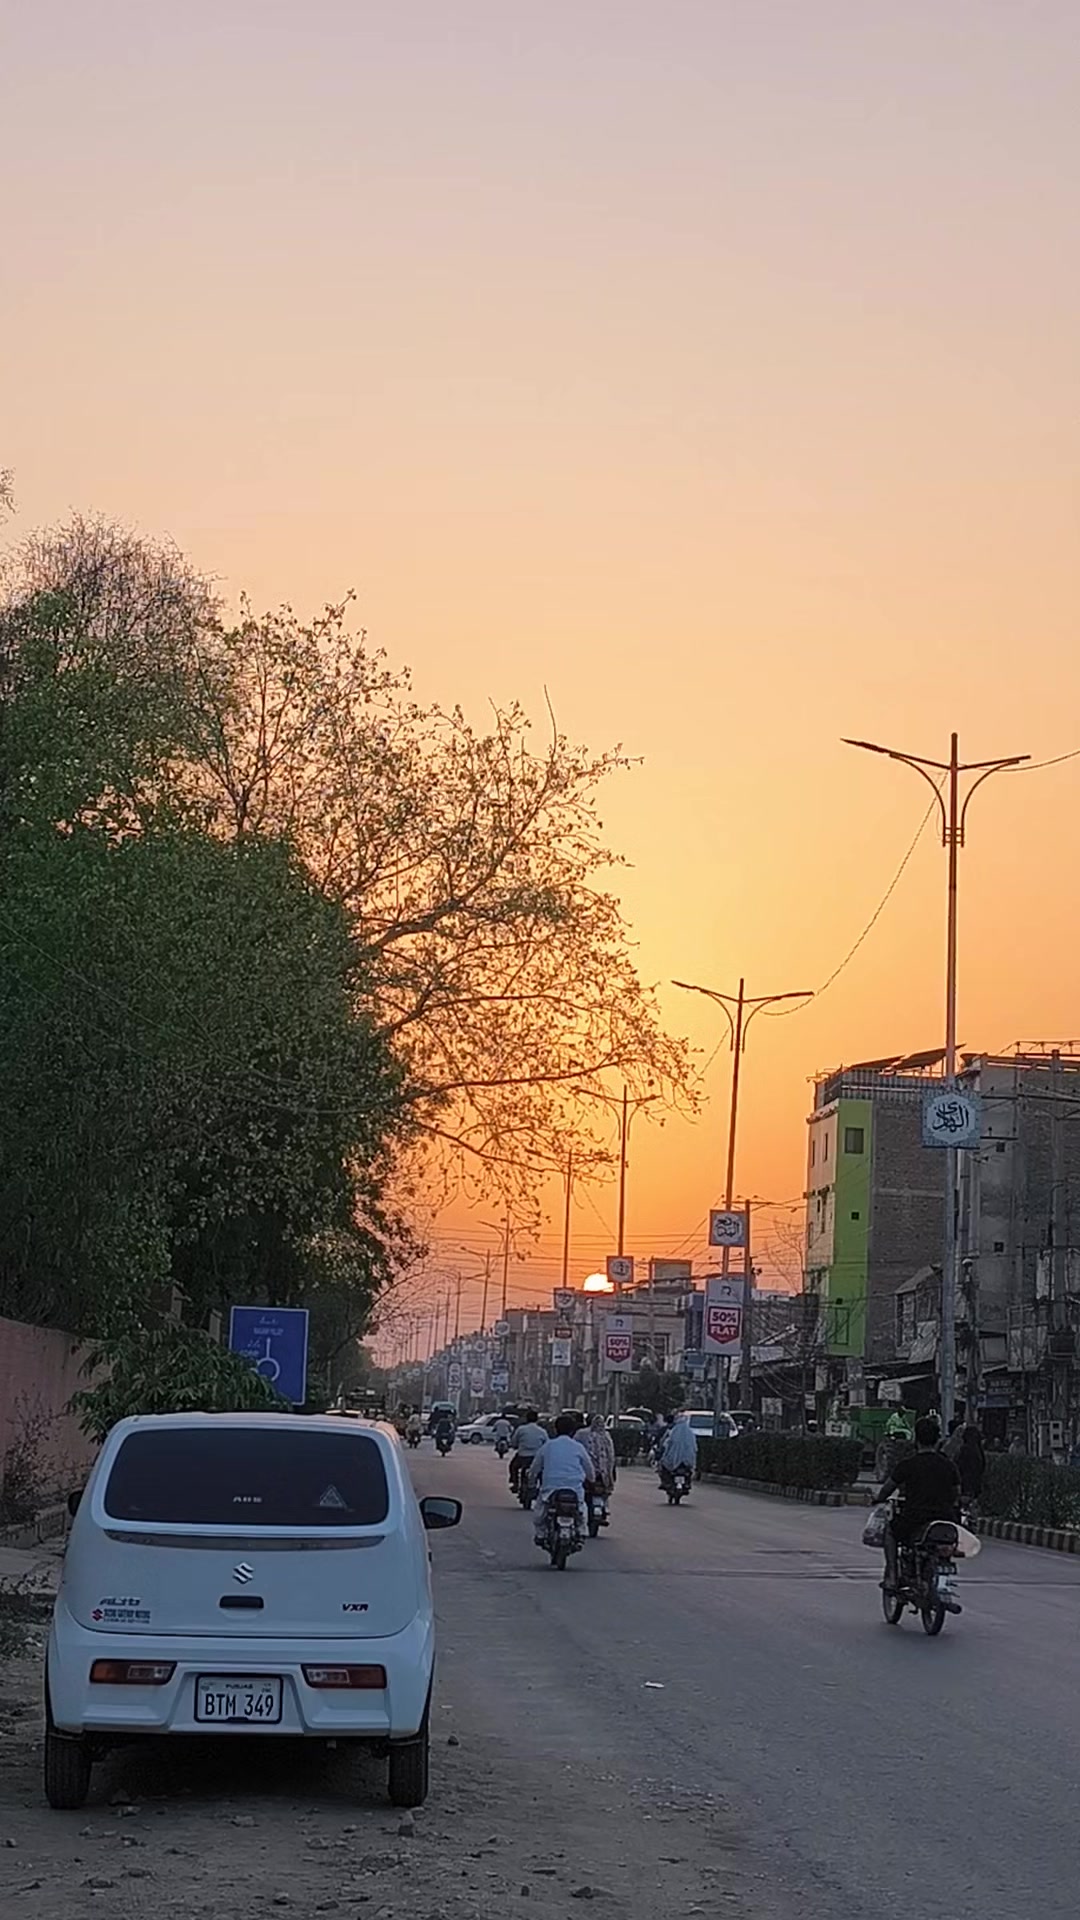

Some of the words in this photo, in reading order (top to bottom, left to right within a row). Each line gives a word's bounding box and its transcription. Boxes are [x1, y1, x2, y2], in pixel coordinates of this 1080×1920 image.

[711, 1311, 737, 1323] 50%
[710, 1325, 737, 1336] FLAT
[342, 1603, 369, 1612] VXR
[204, 1693, 237, 1716] BTM
[243, 1694, 274, 1717] 349
